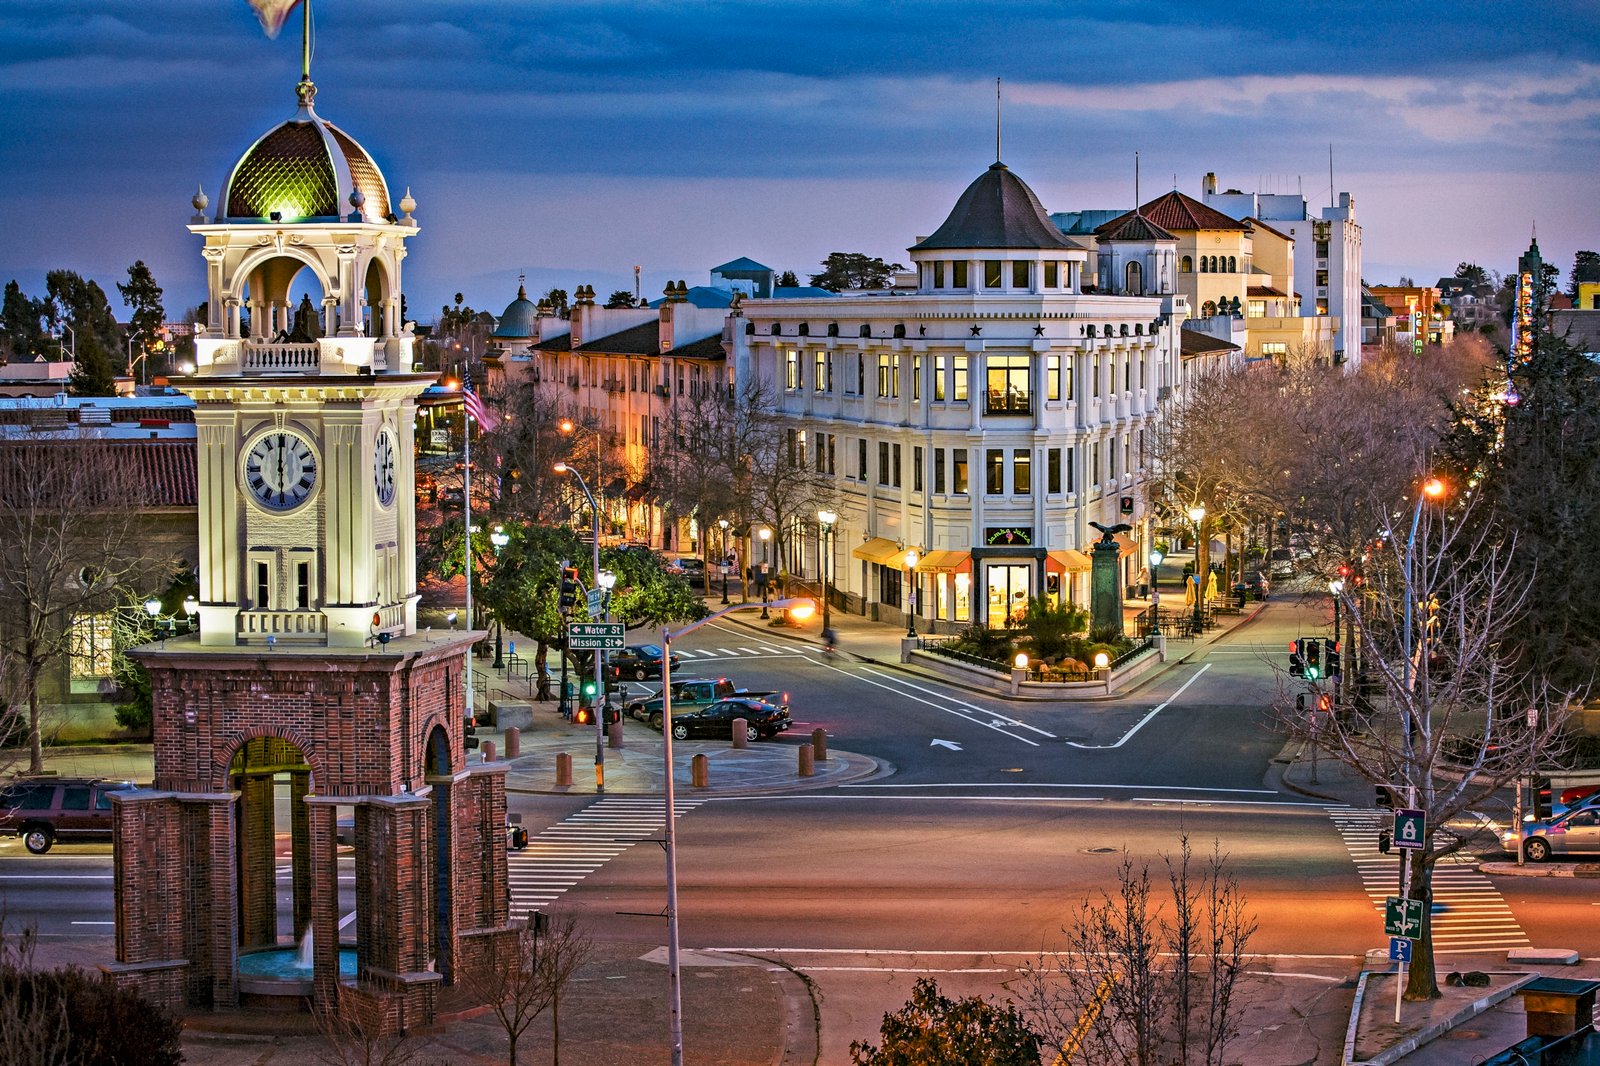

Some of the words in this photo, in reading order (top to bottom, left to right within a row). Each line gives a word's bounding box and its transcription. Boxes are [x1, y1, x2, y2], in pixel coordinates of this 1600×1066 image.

[1415, 311, 1423, 335] DEL
[584, 626, 607, 634] Water
[611, 626, 620, 634] St
[571, 638, 602, 647] Mission
[605, 638, 615, 647] St
[1395, 940, 1408, 953] P
